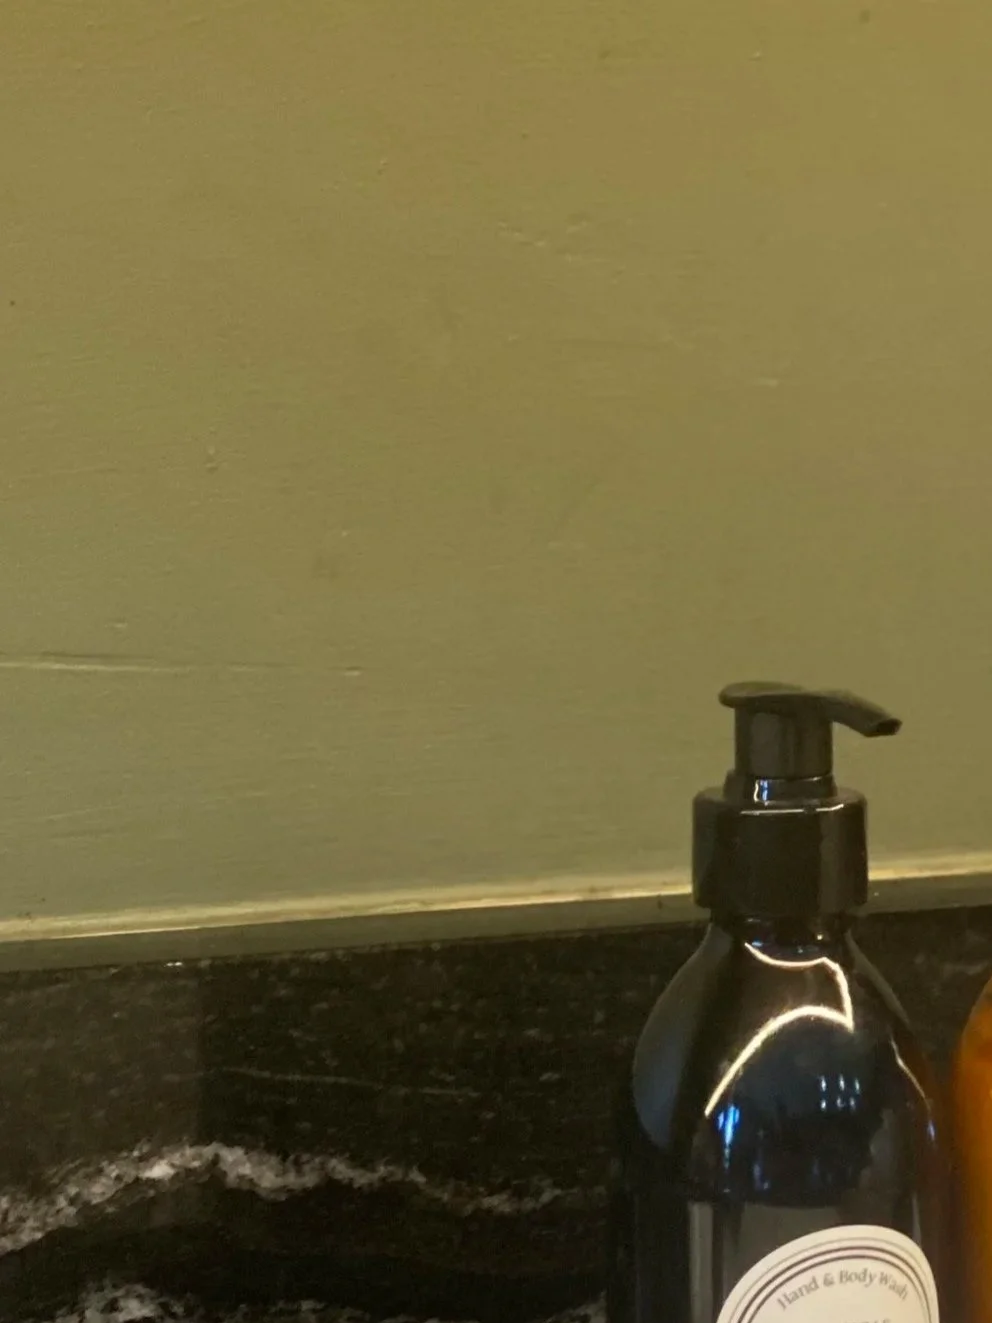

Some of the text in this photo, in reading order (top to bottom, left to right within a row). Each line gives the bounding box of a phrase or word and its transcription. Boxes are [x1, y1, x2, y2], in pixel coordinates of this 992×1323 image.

[776, 1268, 908, 1311] Hand & Body Wash
